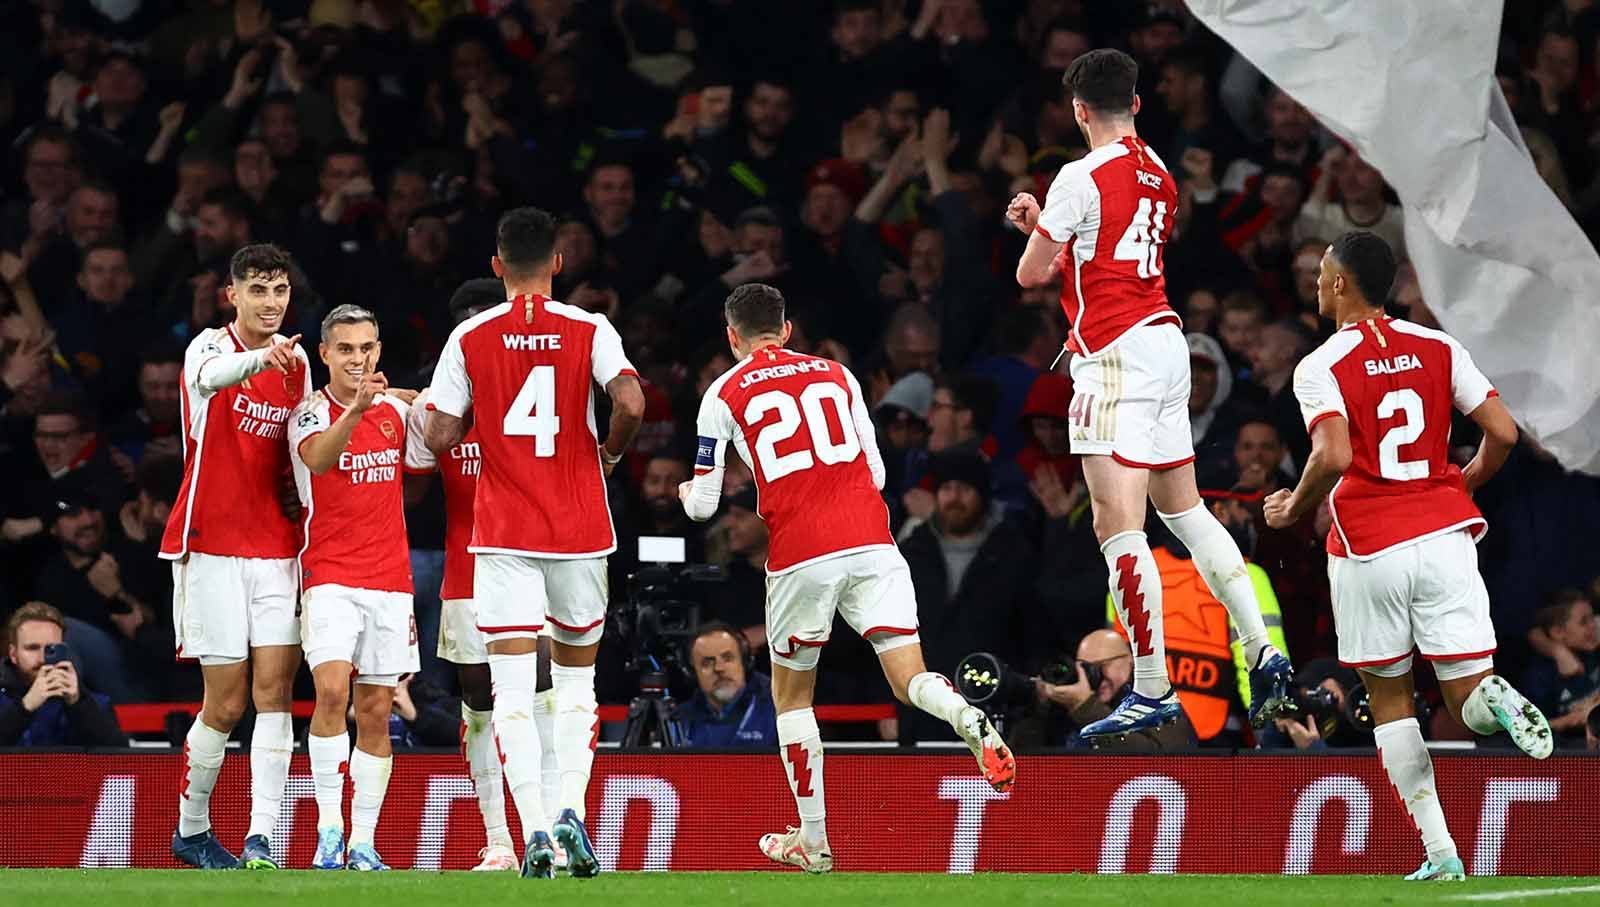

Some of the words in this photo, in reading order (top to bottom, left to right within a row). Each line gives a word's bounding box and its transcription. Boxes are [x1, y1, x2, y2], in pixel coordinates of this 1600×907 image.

[1113, 197, 1167, 279] 41
[502, 333, 562, 351] WHITE
[739, 359, 830, 389] JORGINHO
[1364, 354, 1423, 376] SALIBA
[504, 365, 560, 457] 4
[1069, 393, 1095, 427] 41
[743, 382, 862, 483] 20
[1377, 388, 1430, 481] 2
[462, 459, 479, 475] FLY
